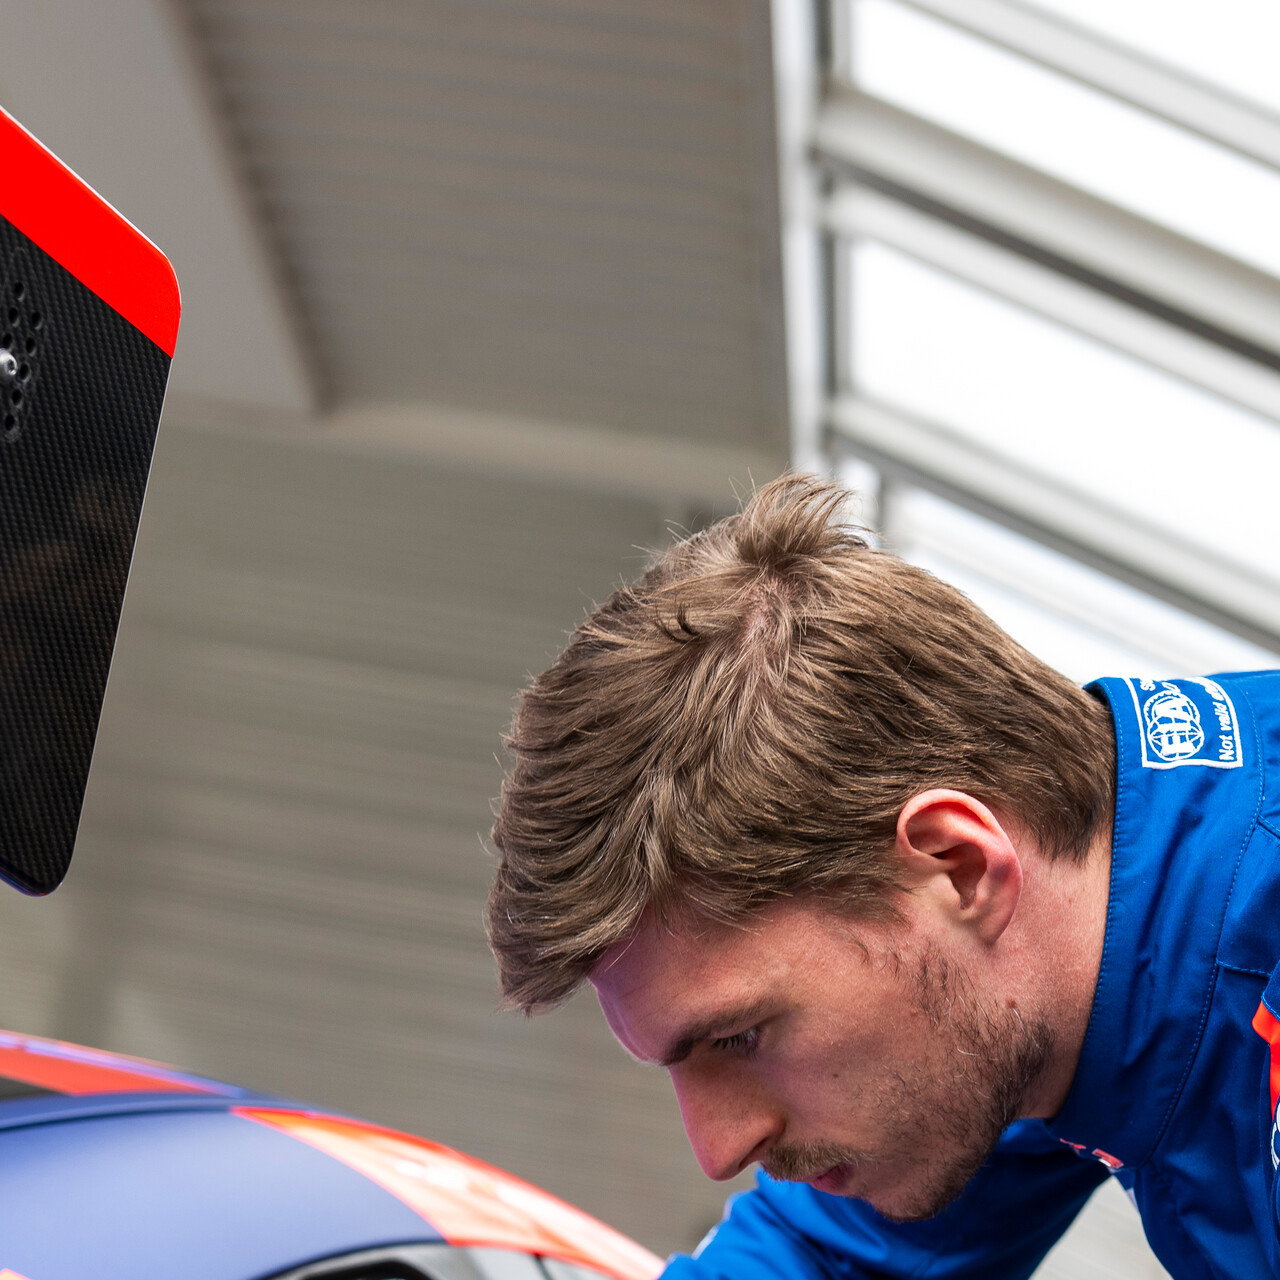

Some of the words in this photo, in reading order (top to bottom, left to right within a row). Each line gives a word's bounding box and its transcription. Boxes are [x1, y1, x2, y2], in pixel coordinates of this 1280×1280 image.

[1150, 696, 1198, 758] FIA
[1212, 701, 1232, 731] valid
[1219, 735, 1235, 760] Not
